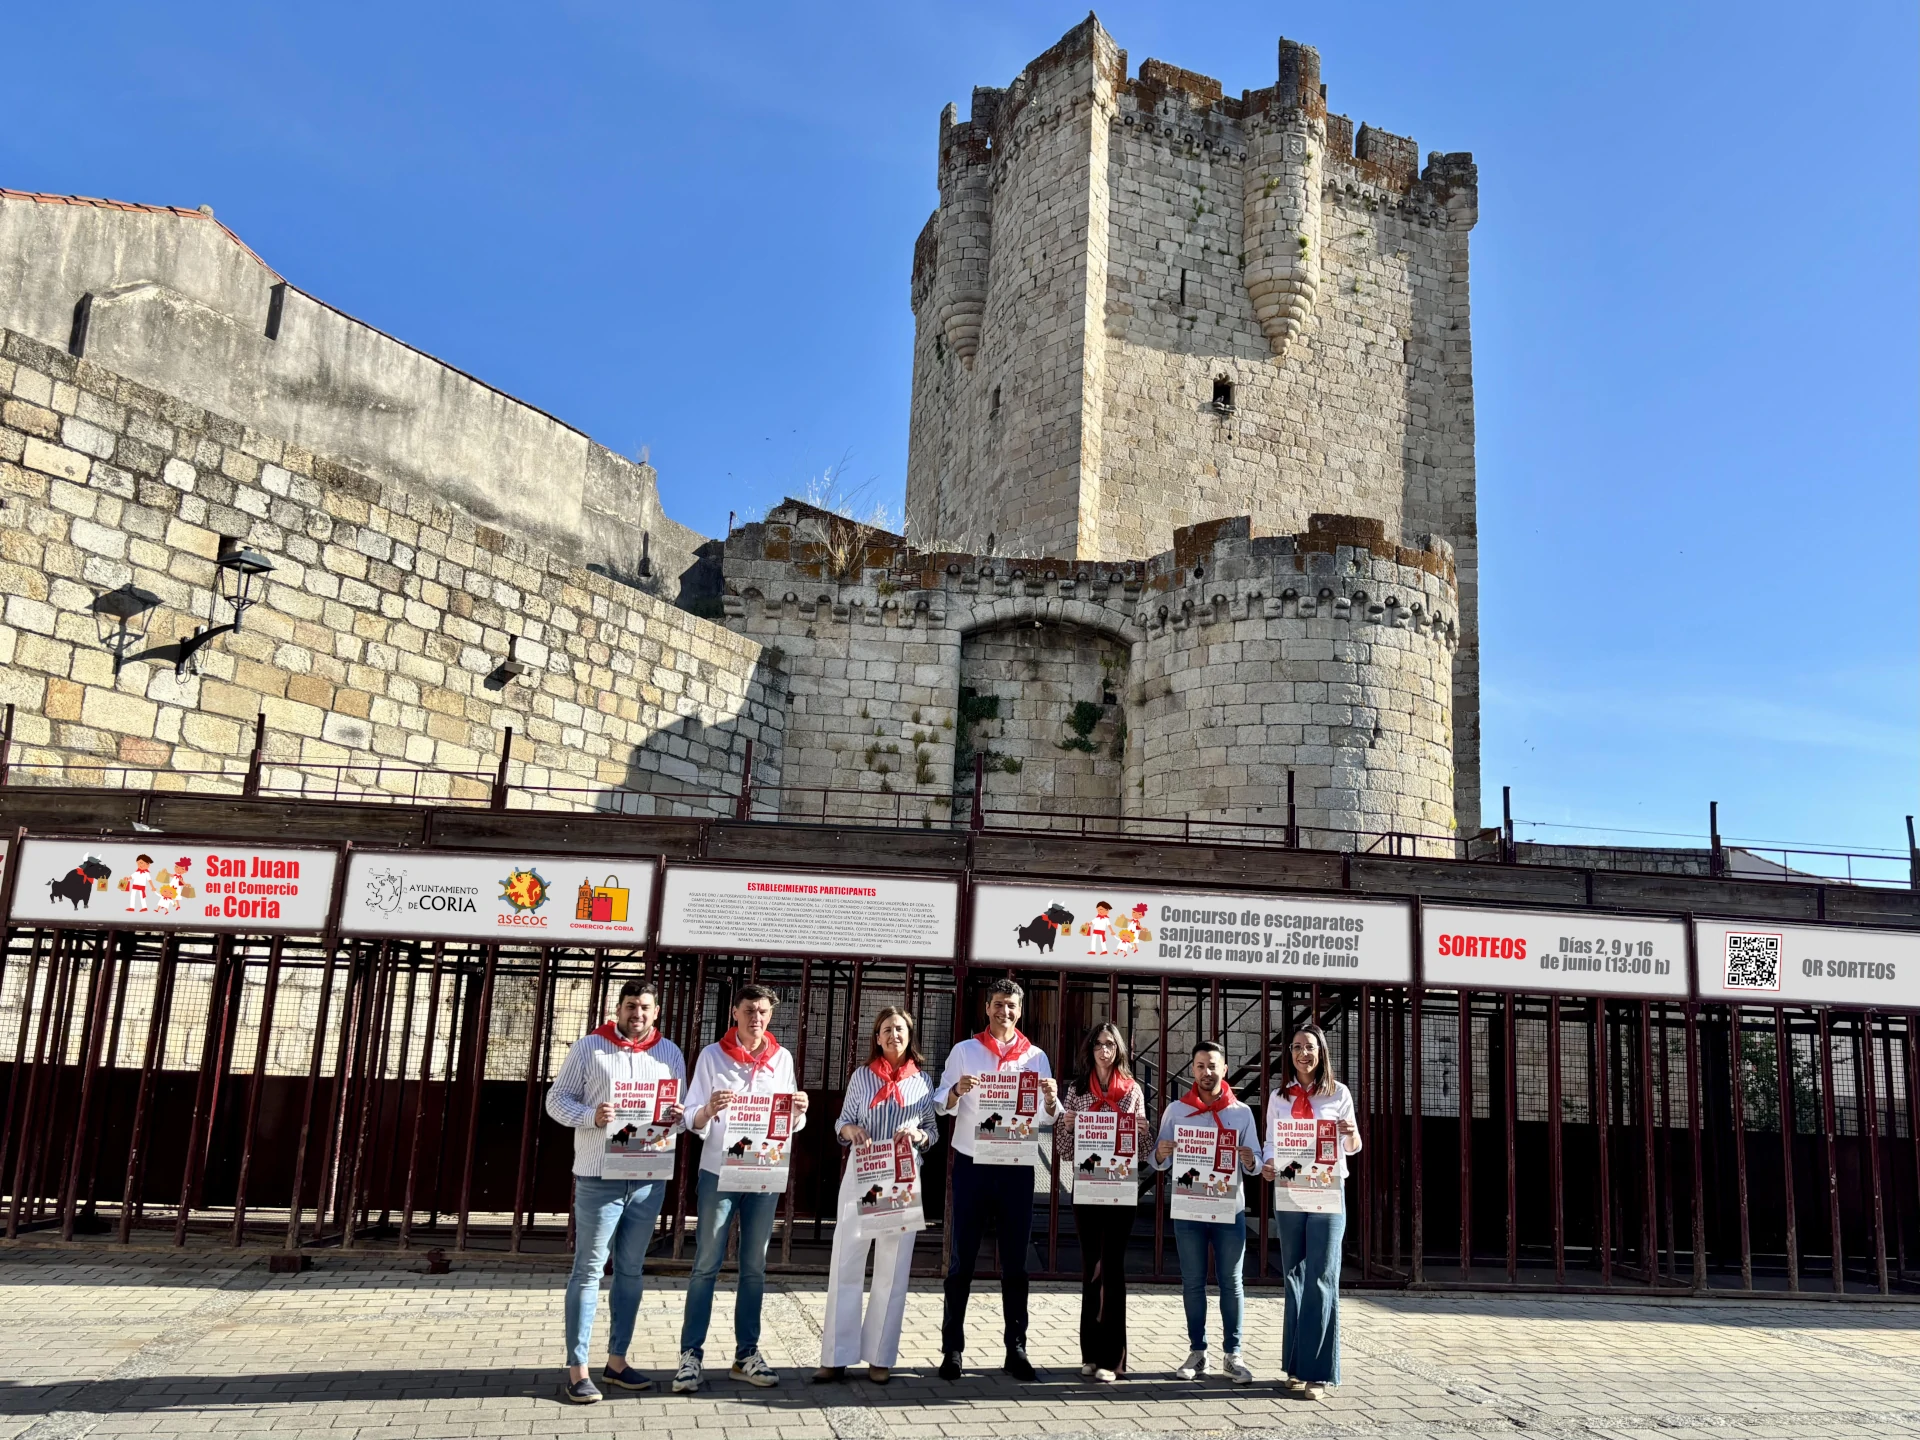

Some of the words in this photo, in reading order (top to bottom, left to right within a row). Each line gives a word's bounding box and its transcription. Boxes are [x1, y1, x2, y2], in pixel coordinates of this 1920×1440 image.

[207, 855, 246, 877] San
[251, 857, 299, 879] Juan
[206, 883, 221, 893] en
[224, 881, 235, 893] el
[239, 881, 298, 895] Comercio
[410, 885, 478, 894] AYUNTAMIENTO
[748, 883, 818, 894] ESTABLECIMIENTOS
[820, 886, 876, 896] PARTICIPANTES
[205, 904, 220, 917] de
[224, 896, 280, 918] Coria
[420, 895, 476, 912] CORIA
[498, 914, 547, 926] asecoc
[1161, 906, 1237, 925] Concurso
[1241, 910, 1260, 926] de
[1264, 914, 1363, 932] escaparates
[1160, 927, 1260, 945] sanjuaneros
[1264, 933, 1272, 948] y
[1439, 934, 1526, 960] SORTEOS
[1559, 937, 1592, 954] Días
[1596, 939, 1607, 956] 2,
[1612, 939, 1621, 955] 9
[1622, 943, 1633, 959] y
[1636, 941, 1653, 957] 16
[1159, 943, 1181, 958] Del
[1184, 945, 1202, 959] 26
[1205, 946, 1222, 960] de
[1226, 949, 1263, 963] mayo
[1266, 950, 1279, 963] al
[1282, 950, 1299, 965] 20
[1303, 951, 1320, 966] de
[1323, 952, 1358, 968] junio
[1540, 954, 1559, 969] de
[1562, 955, 1601, 971] junio
[1605, 955, 1651, 974] (13:00
[1655, 959, 1670, 975] h)
[1802, 959, 1823, 977] QR
[1827, 960, 1895, 980] SORTEOS
[981, 1073, 996, 1082] San
[998, 1074, 1016, 1082] Juan
[615, 1081, 632, 1090] San
[634, 1082, 655, 1091] Juan
[750, 1095, 770, 1104] Juan
[987, 1090, 1009, 1099] Coria
[622, 1099, 646, 1108] Coria
[738, 1112, 761, 1121] Coria
[1079, 1115, 1093, 1123] San
[1096, 1115, 1114, 1123] Juan
[1277, 1122, 1292, 1130] San
[1295, 1122, 1314, 1131] Juan
[1086, 1131, 1107, 1139] Coria
[1178, 1128, 1193, 1137] San
[1196, 1130, 1214, 1139] Juan
[873, 1143, 892, 1152] Juan
[1285, 1138, 1307, 1147] Coria
[1185, 1145, 1207, 1154] Coria
[864, 1161, 886, 1171] Coria
